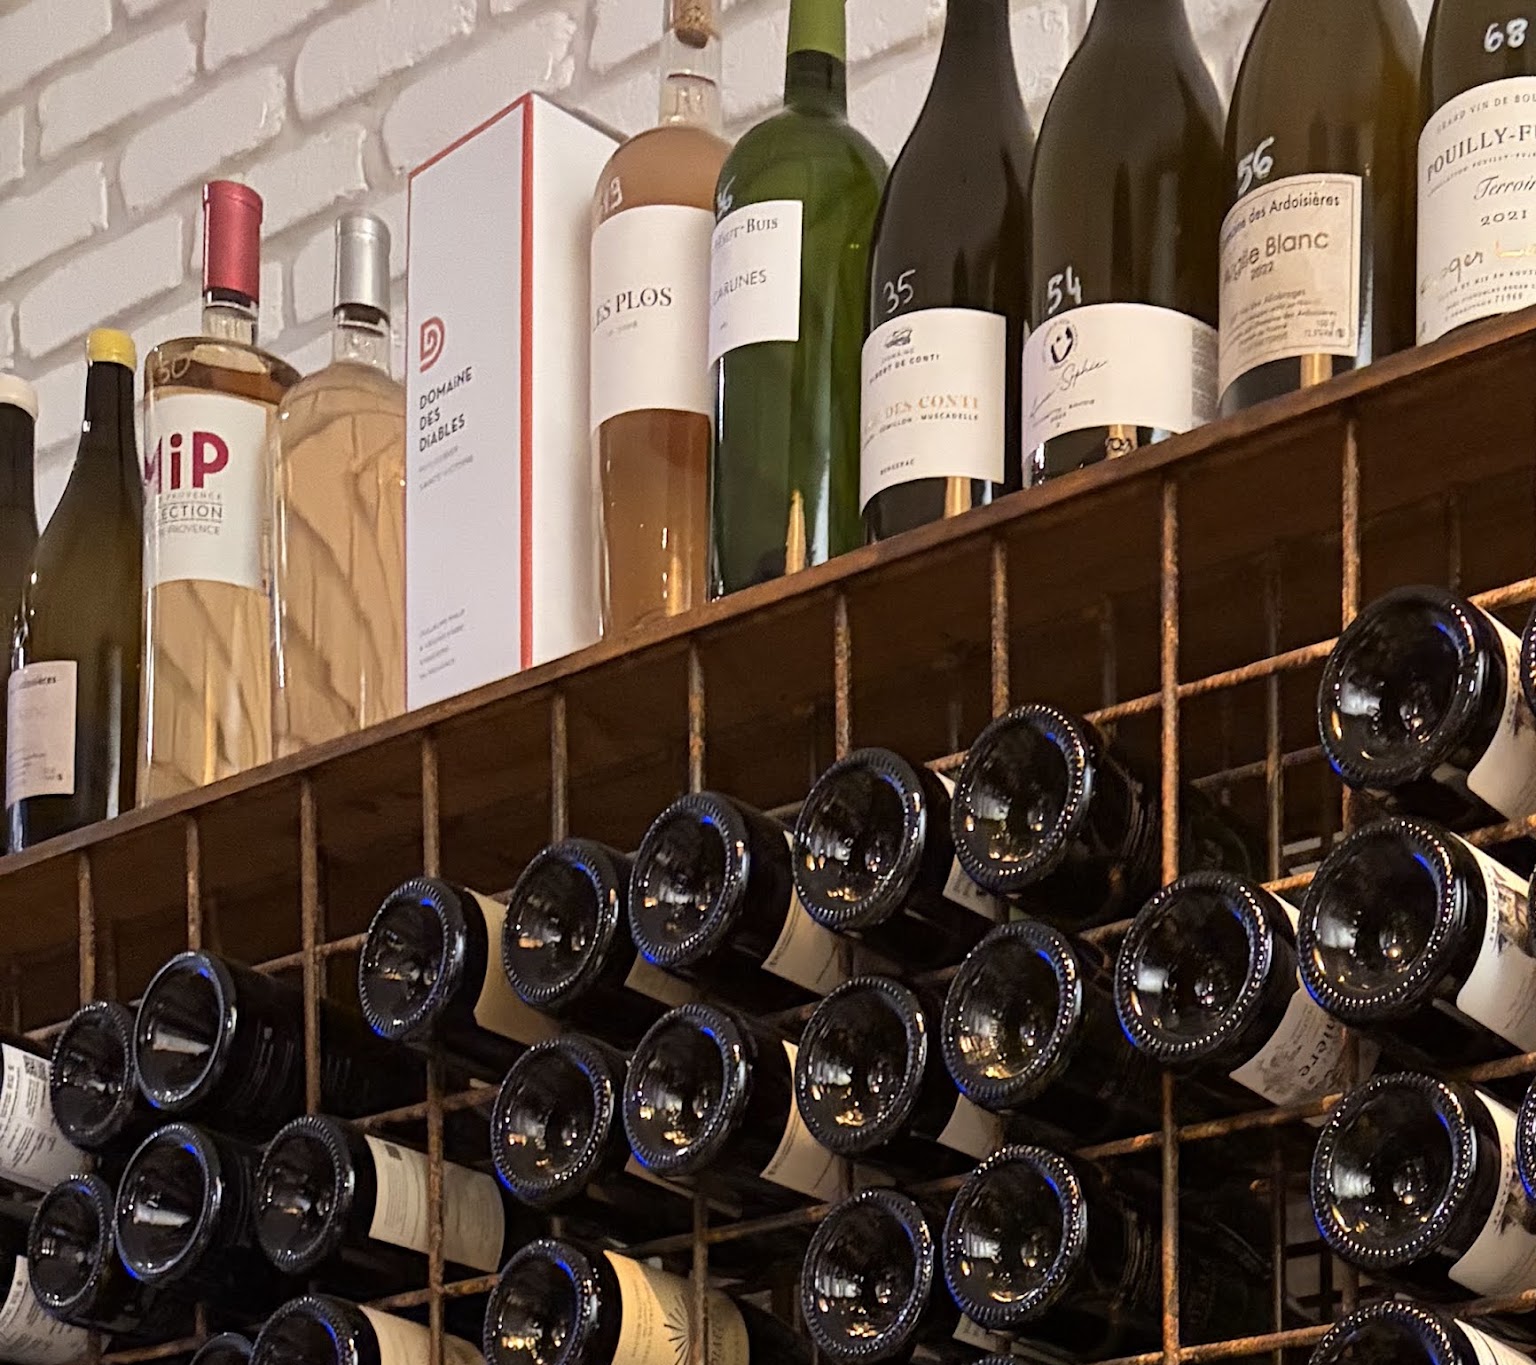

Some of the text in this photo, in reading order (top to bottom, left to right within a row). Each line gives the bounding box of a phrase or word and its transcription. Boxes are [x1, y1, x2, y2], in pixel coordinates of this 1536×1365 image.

[1483, 17, 1528, 52] 68
[1493, 95, 1509, 106] DE
[1237, 136, 1275, 198] 56
[1249, 191, 1341, 224] des Ardoisières
[1480, 208, 1528, 227] 2021
[1265, 230, 1330, 258] Blanc
[615, 286, 673, 313] PLOS
[882, 268, 917, 314] 35
[1047, 264, 1083, 315] 54
[918, 393, 979, 412] CONTI
[419, 406, 441, 432] DES
[160, 504, 224, 521] ECTION
